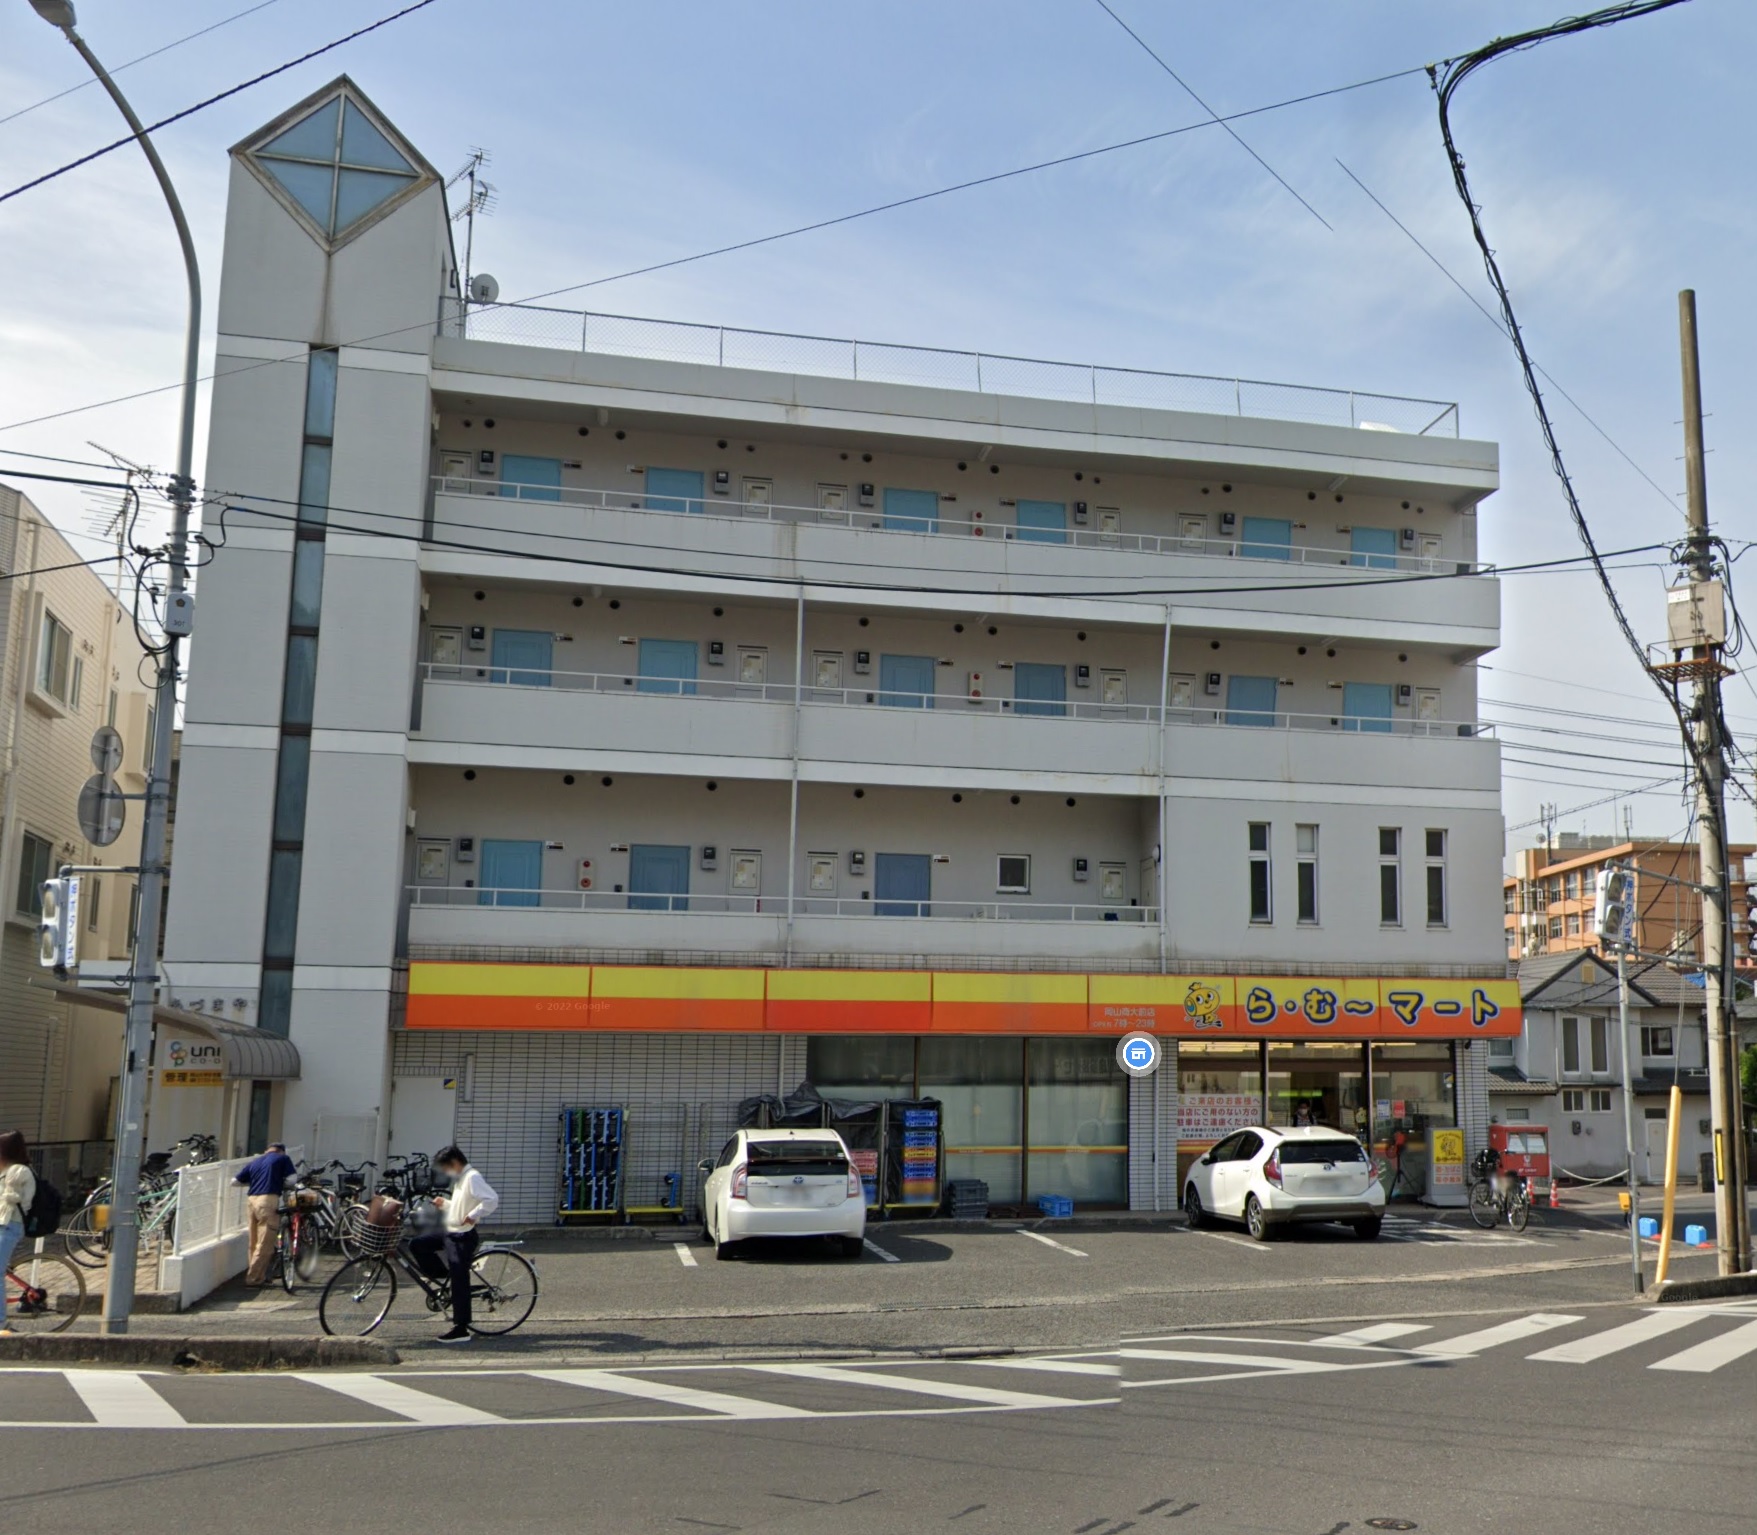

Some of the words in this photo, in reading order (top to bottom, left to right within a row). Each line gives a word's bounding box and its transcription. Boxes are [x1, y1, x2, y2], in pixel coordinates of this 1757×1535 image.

[1189, 1096, 1260, 1105] ご来店のお客様へ
[1177, 1108, 1258, 1117] 当店にご用のない方の
[1177, 1118, 1258, 1127] 駐車はご遠慮ください
